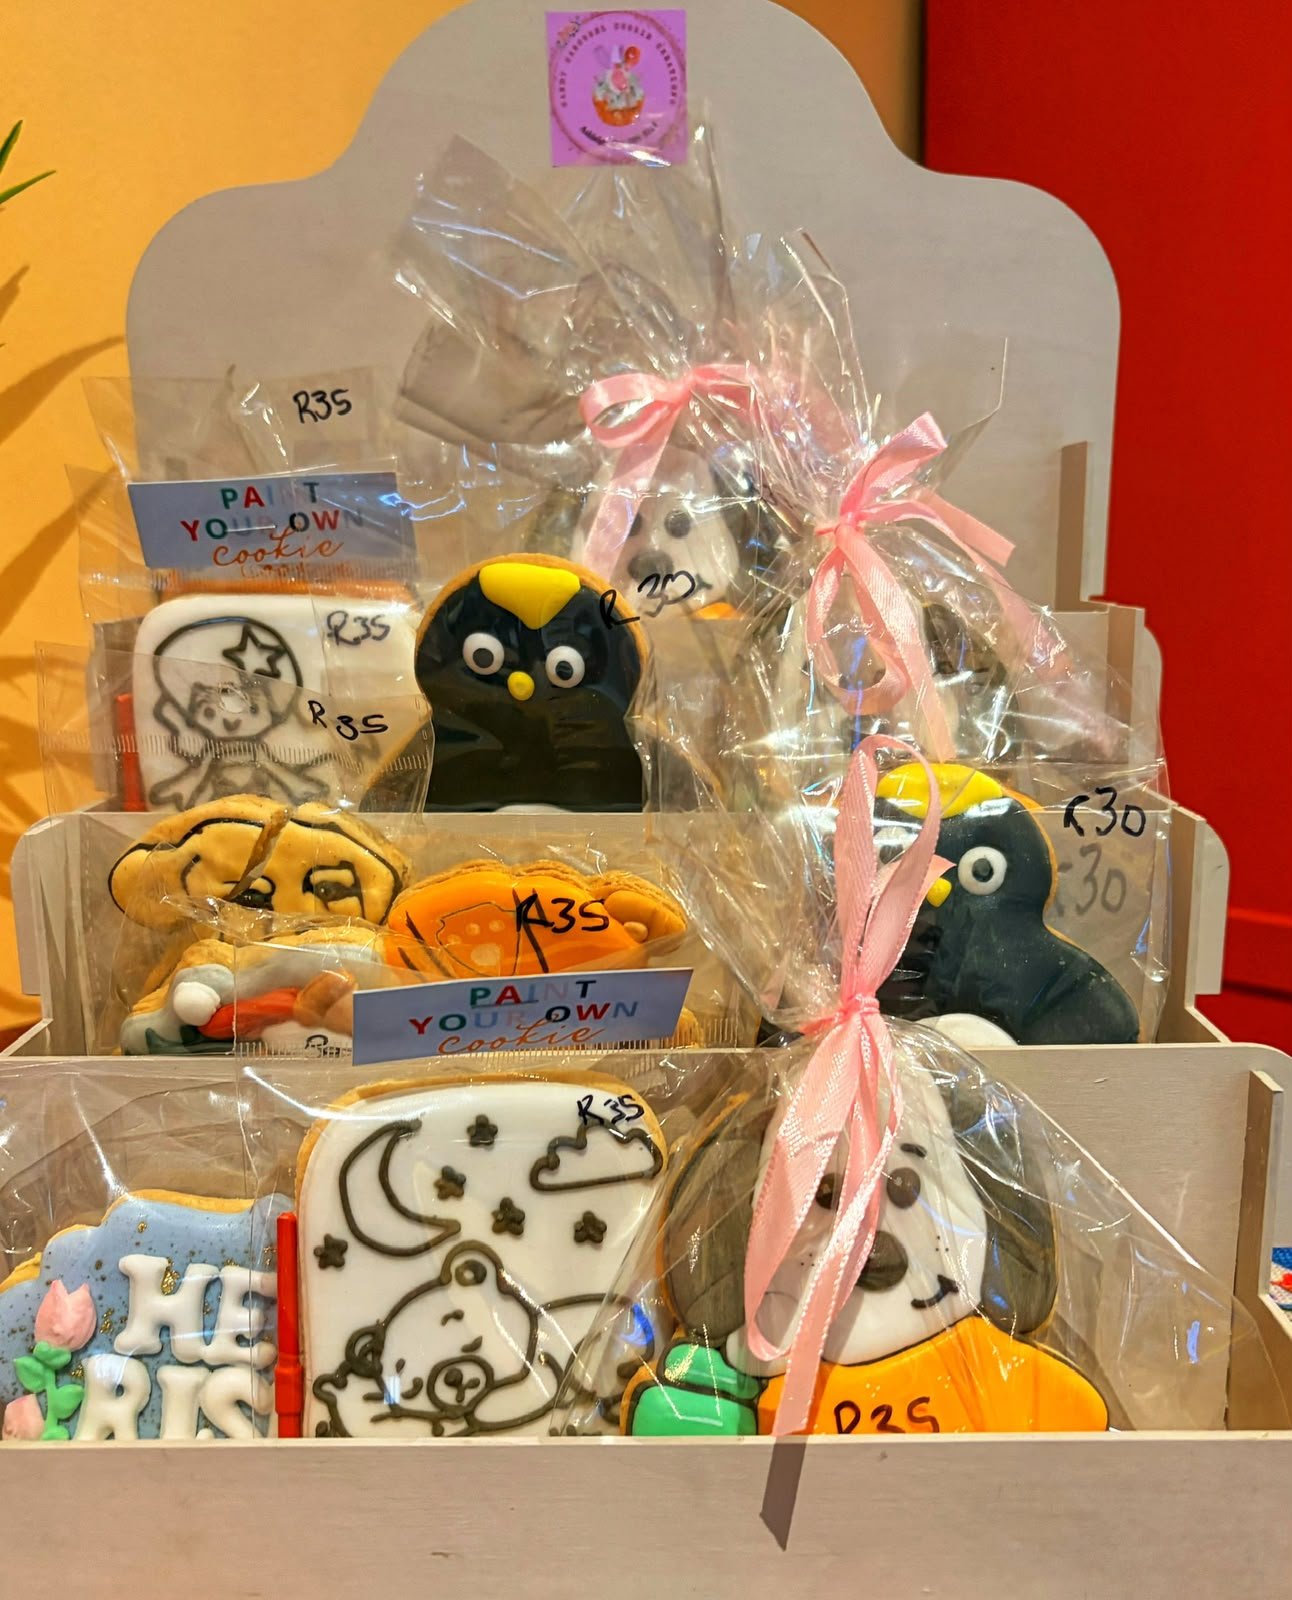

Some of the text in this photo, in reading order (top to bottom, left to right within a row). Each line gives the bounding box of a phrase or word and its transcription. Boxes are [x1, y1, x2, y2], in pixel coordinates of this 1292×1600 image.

[292, 388, 352, 424] R35
[221, 481, 320, 509] PAINT
[180, 509, 364, 542] YOUR OWN
[213, 524, 344, 566] cookie
[326, 610, 391, 646] R35
[307, 700, 389, 741] R35
[470, 980, 597, 1006] PAINT
[409, 1001, 638, 1035] YOUR OWN
[438, 1014, 605, 1055] cookie
[576, 1094, 645, 1126] R35
